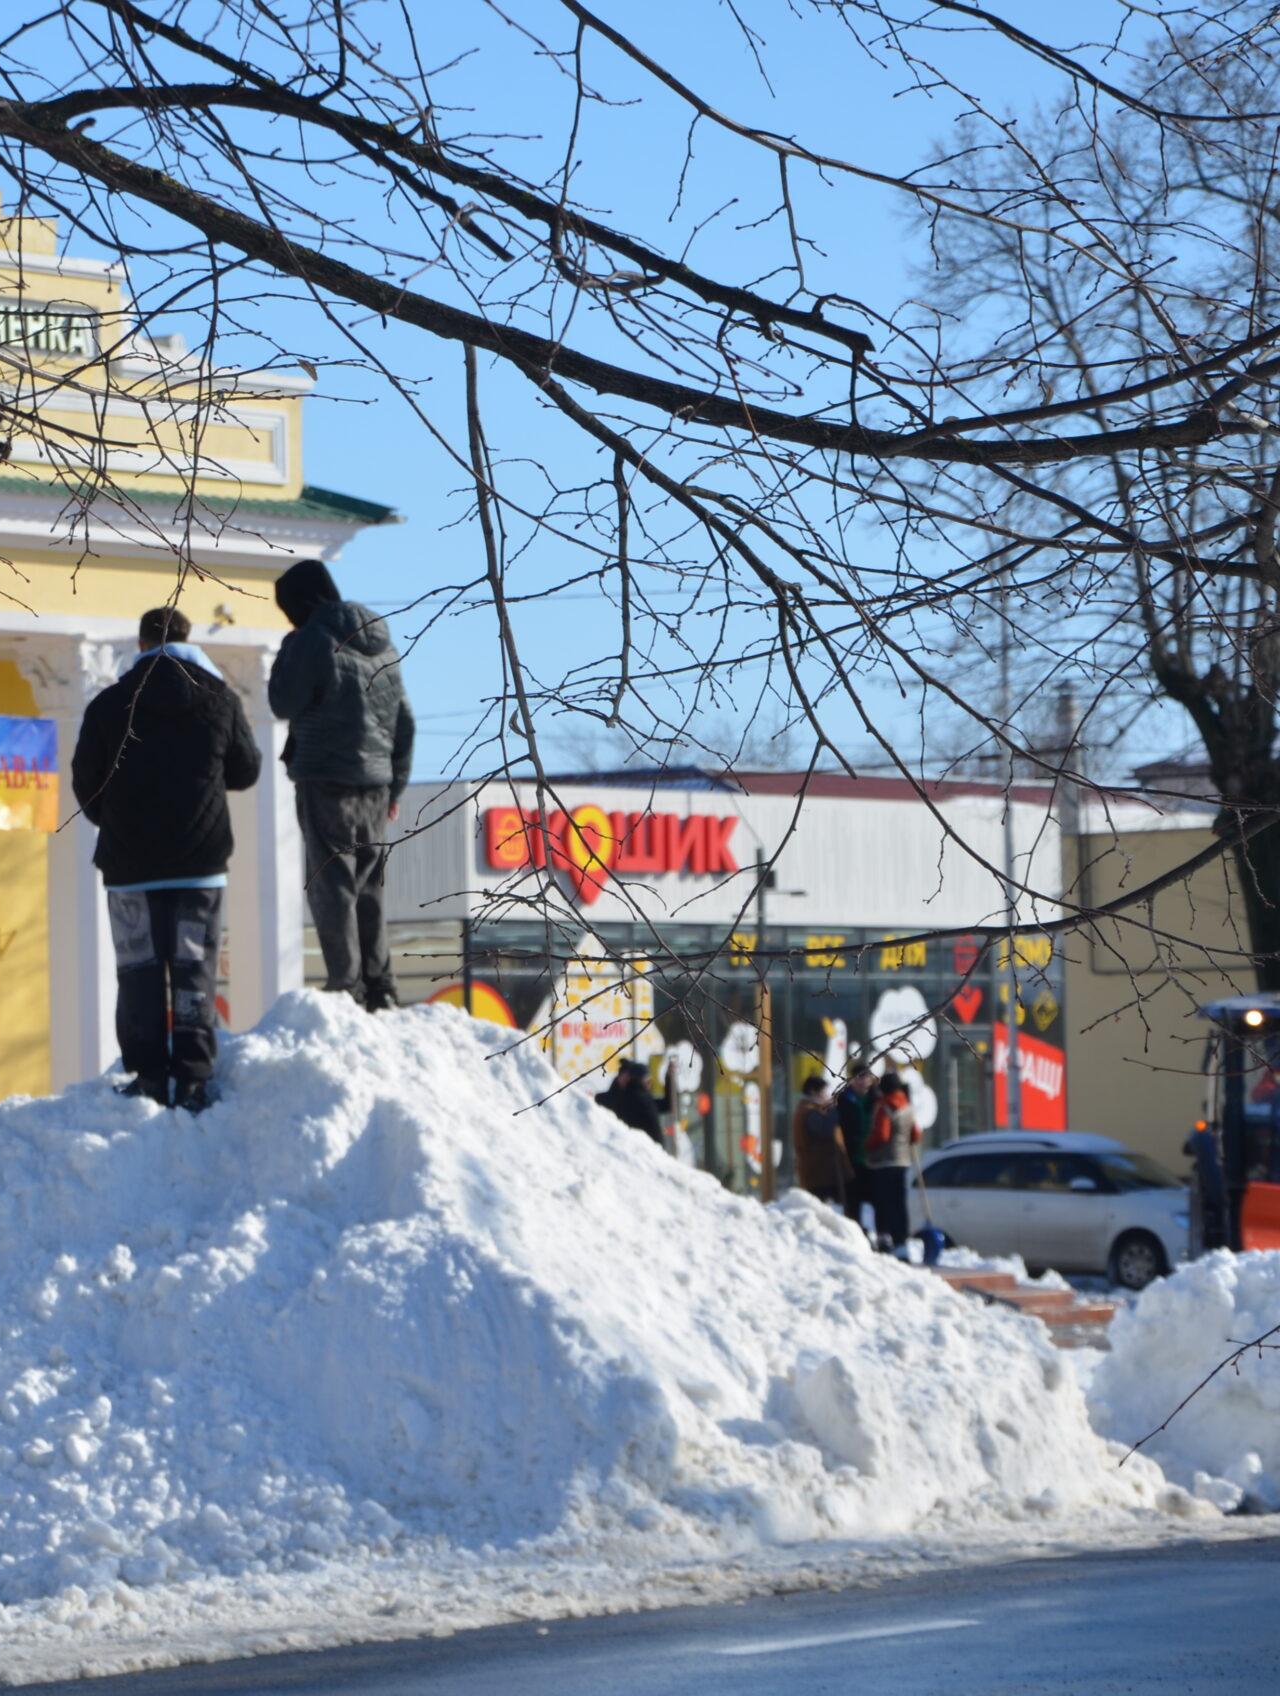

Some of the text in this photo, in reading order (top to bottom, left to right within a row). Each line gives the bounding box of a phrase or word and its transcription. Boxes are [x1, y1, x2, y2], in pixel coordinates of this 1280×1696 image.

[804, 933, 847, 969] ВСЕ
[880, 933, 927, 973] ДЛЯ
[993, 1038, 1064, 1101] КАЩІ
